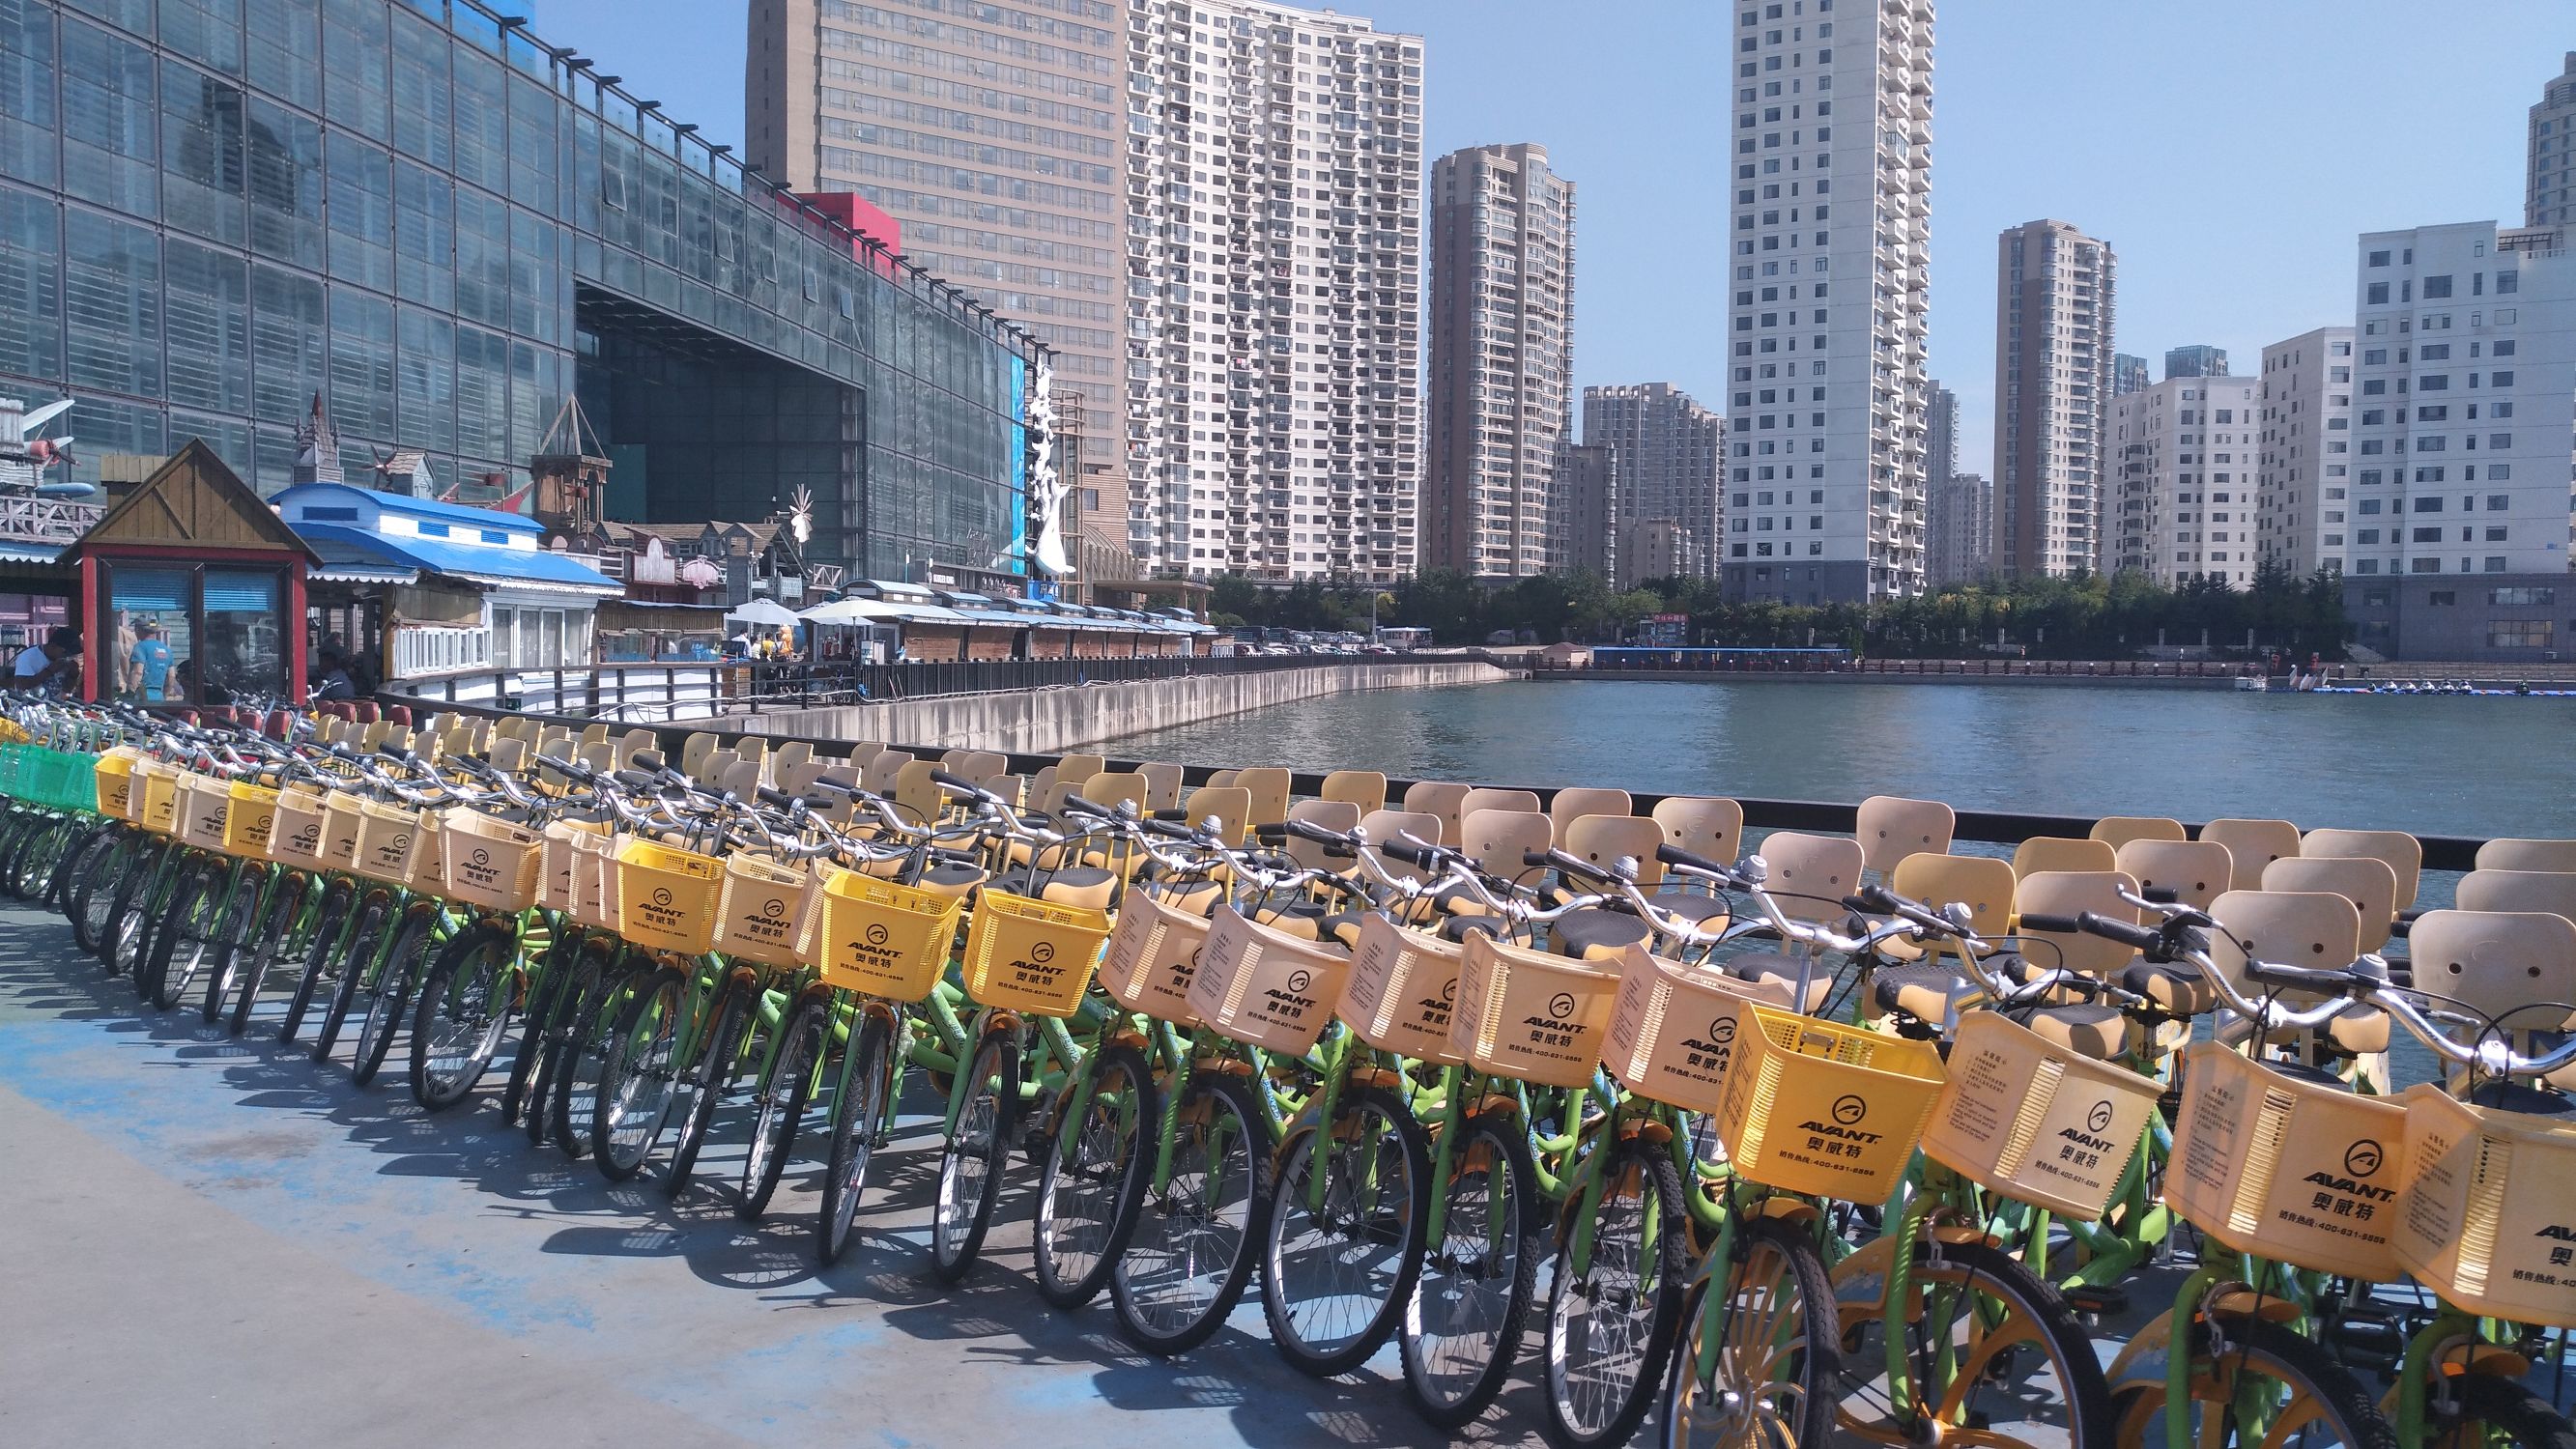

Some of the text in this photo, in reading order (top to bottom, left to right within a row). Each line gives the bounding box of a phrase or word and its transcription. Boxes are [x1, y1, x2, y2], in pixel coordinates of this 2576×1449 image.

[855, 952, 892, 968] 奥威特
[1016, 972, 1053, 986] 奥威特
[1267, 1001, 1302, 1018] 奥威特
[1421, 1010, 1450, 1026] 奥威
[1531, 1030, 1573, 1047] 奥威特
[1806, 1136, 1862, 1159] 奥威特
[2059, 1145, 2100, 1170] 奥威特
[2311, 1192, 2375, 1221] 奥威特
